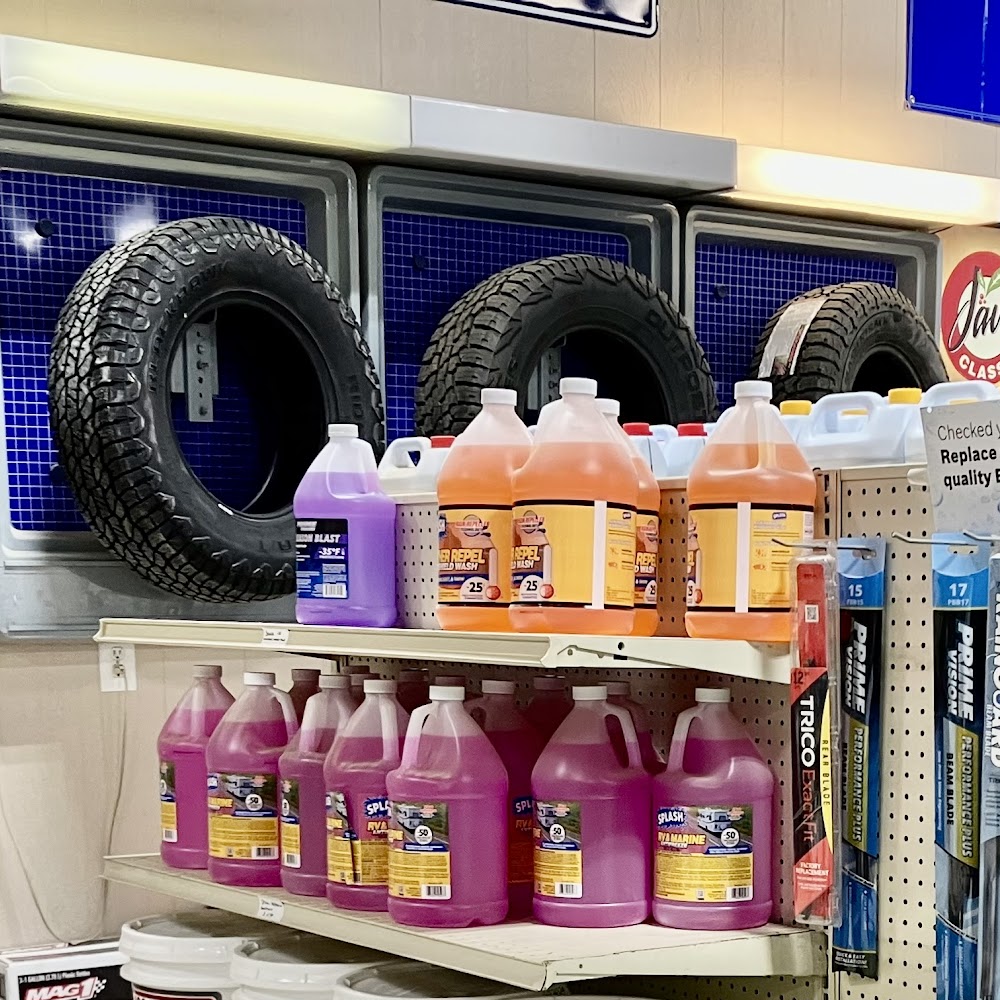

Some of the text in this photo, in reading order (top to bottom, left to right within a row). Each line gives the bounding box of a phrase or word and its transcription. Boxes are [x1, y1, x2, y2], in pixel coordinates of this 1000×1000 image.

[937, 420, 993, 441] Checked
[940, 444, 996, 466] Replace
[943, 468, 992, 489] quality
[314, 534, 341, 543] BLAST
[452, 549, 485, 564] REPEL
[457, 562, 478, 571] WASH
[848, 584, 863, 597] 15
[949, 583, 968, 596] 17
[852, 621, 867, 715] PRIME
[958, 622, 974, 722] PRIME
[947, 650, 959, 717] VISION
[800, 695, 816, 767] TRICO
[853, 727, 863, 842] PERFORMANCE PLUS
[946, 753, 954, 825] BEAM BLADE
[961, 735, 974, 858] PERFORMANCE PLUS
[657, 809, 684, 825] SPLASH
[672, 833, 707, 845] MARINE
